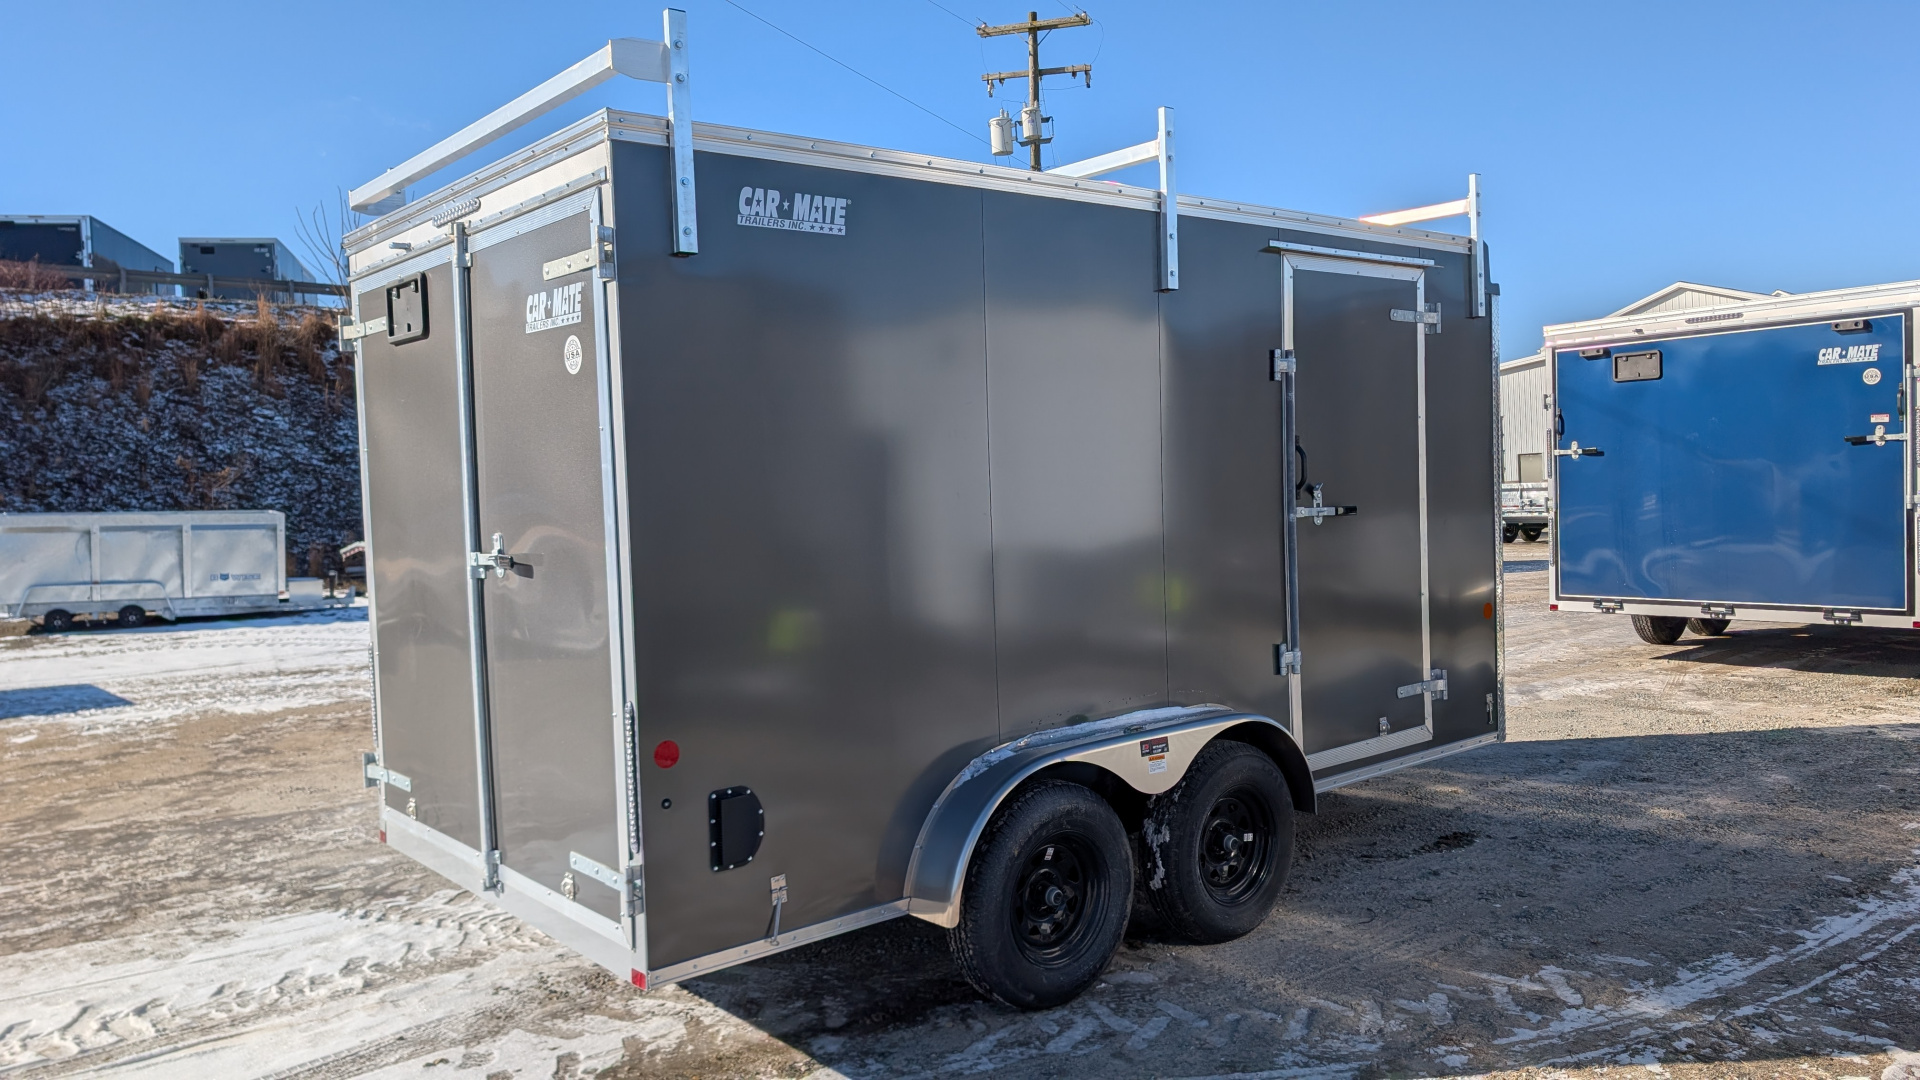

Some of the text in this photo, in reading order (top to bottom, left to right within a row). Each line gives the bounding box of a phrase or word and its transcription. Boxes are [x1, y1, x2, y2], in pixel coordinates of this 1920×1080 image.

[739, 186, 847, 225] CAR MATE
[739, 215, 807, 230] TRAILERS INC.
[526, 281, 582, 322] CAR MATE
[1819, 344, 1879, 360] CAR MATE
